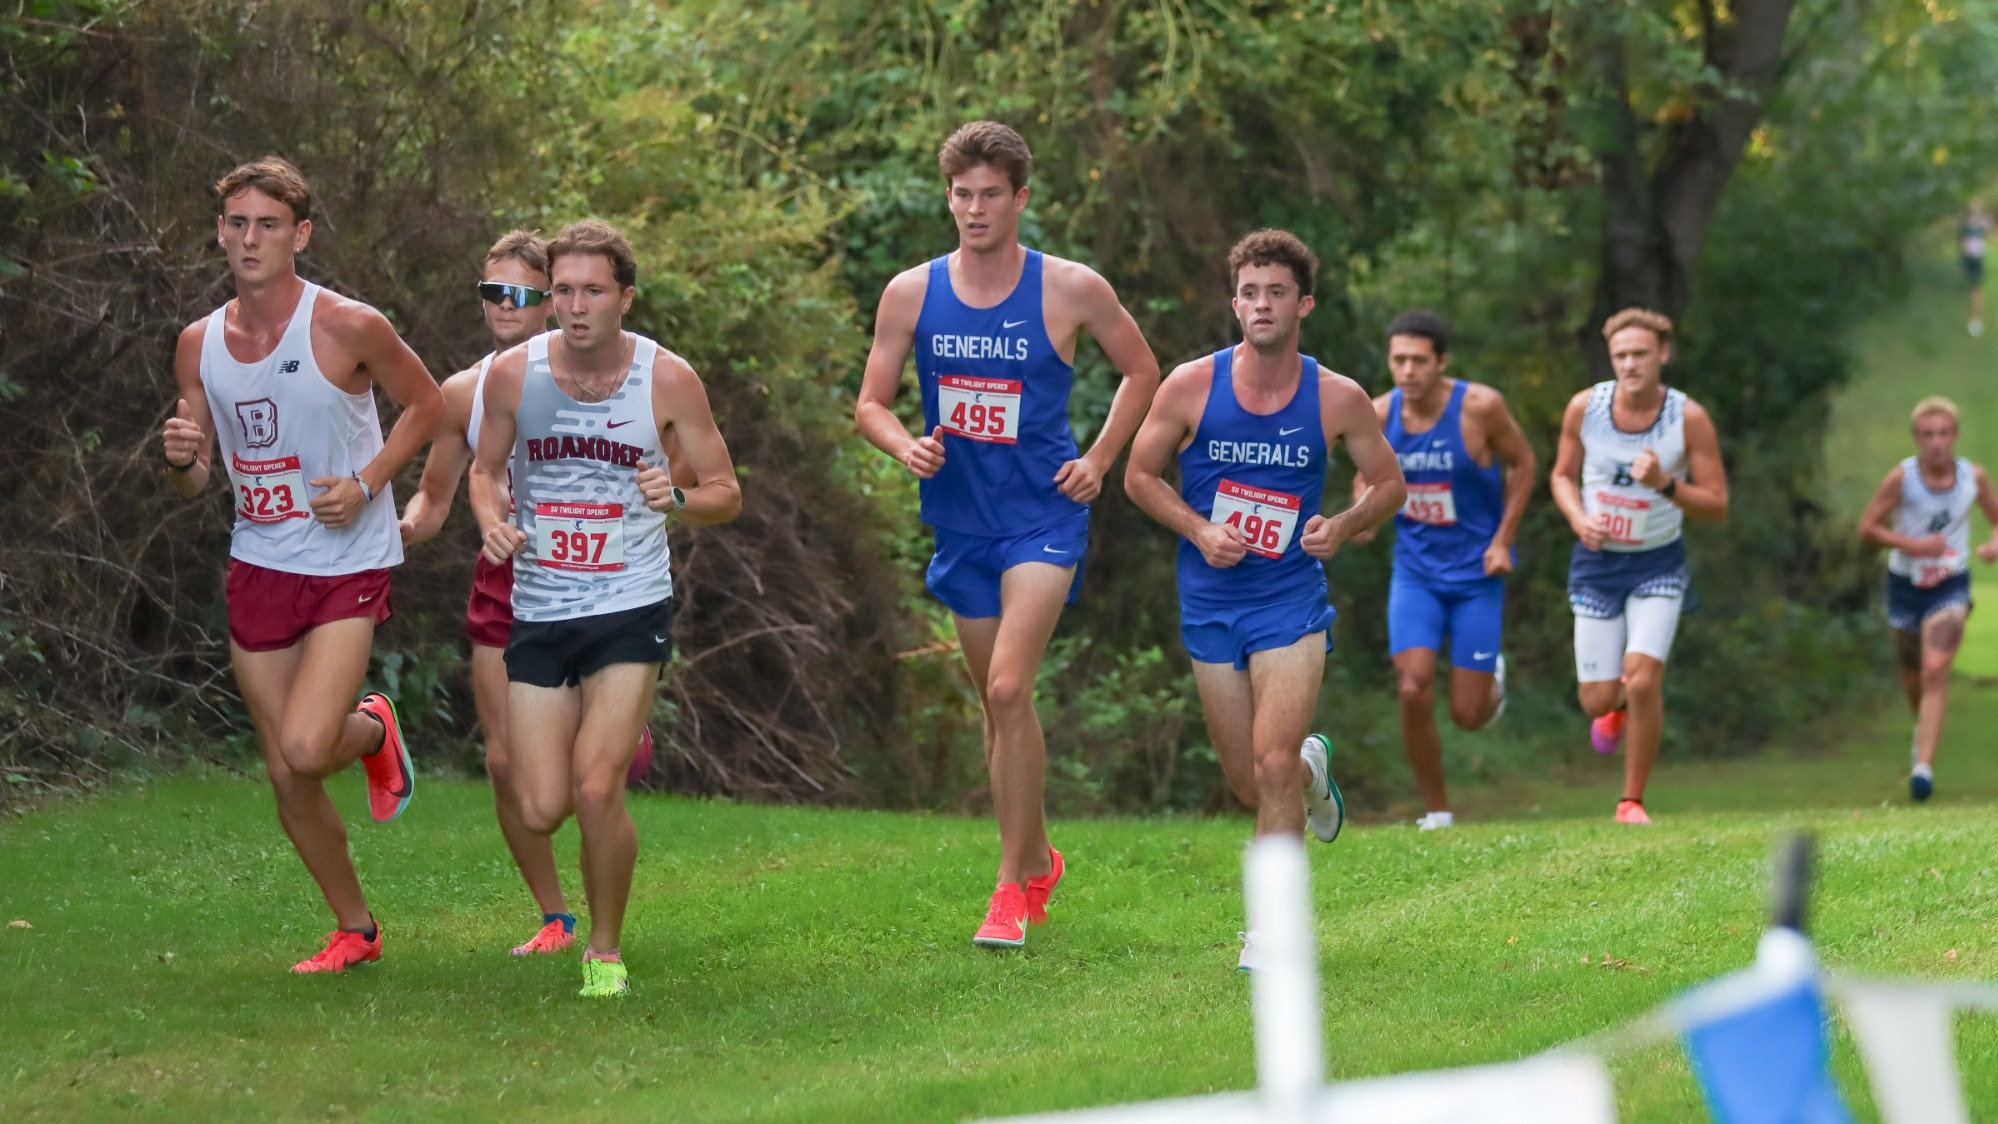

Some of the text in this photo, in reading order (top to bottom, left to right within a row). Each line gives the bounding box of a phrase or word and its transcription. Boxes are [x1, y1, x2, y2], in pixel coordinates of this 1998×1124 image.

[932, 333, 1028, 361] GENERALS
[961, 379, 986, 388] TWILIGHT
[987, 382, 1008, 390] OPENER
[235, 397, 278, 449] B
[950, 401, 1006, 435] 495
[264, 461, 287, 471] OPENER
[527, 436, 644, 468] ROANOKE
[1209, 440, 1310, 468] GENERALS
[240, 484, 294, 515] 323
[1241, 488, 1267, 500] TWILIGHT
[1268, 495, 1288, 505] OPENER
[560, 506, 585, 515] TWILIGHT
[587, 508, 609, 516] OPENER
[551, 530, 608, 564] 397
